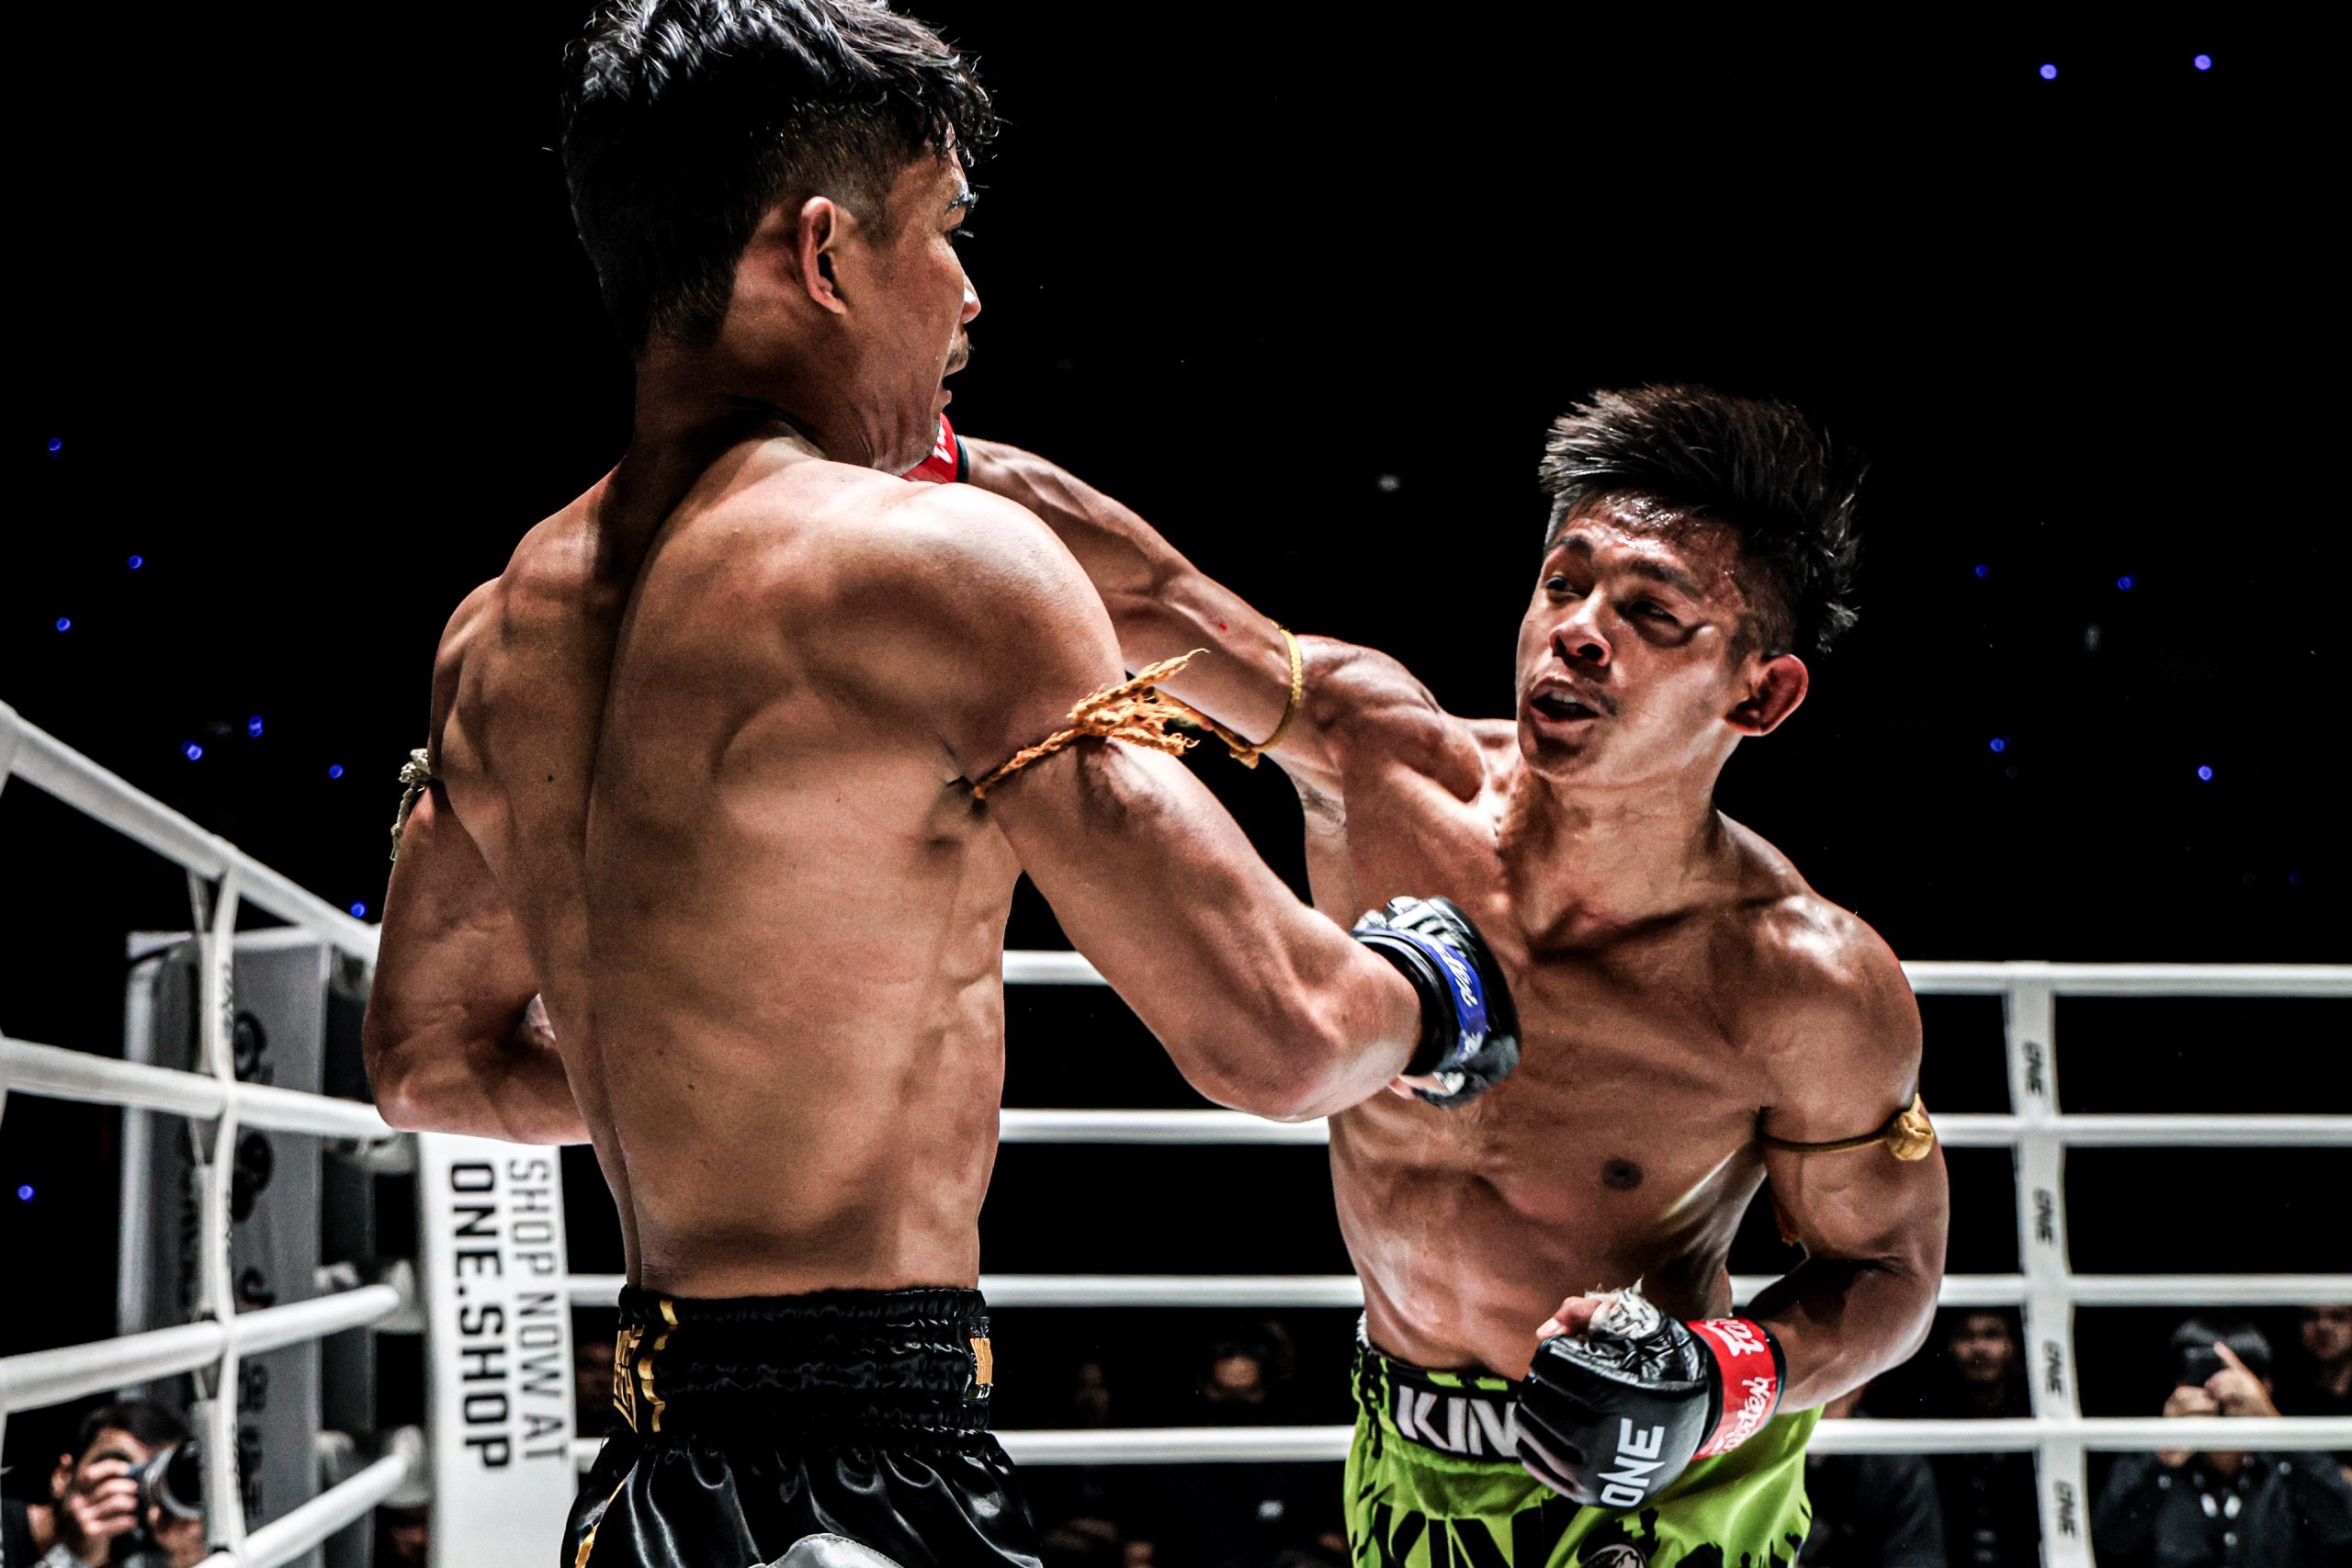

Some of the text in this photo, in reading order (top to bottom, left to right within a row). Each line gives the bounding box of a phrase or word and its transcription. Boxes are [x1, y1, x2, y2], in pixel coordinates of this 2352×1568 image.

[451, 1162, 510, 1467] ONE.SHOP
[508, 1159, 567, 1461] SHOP NOW AT
[1597, 1417, 1666, 1507] ONE
